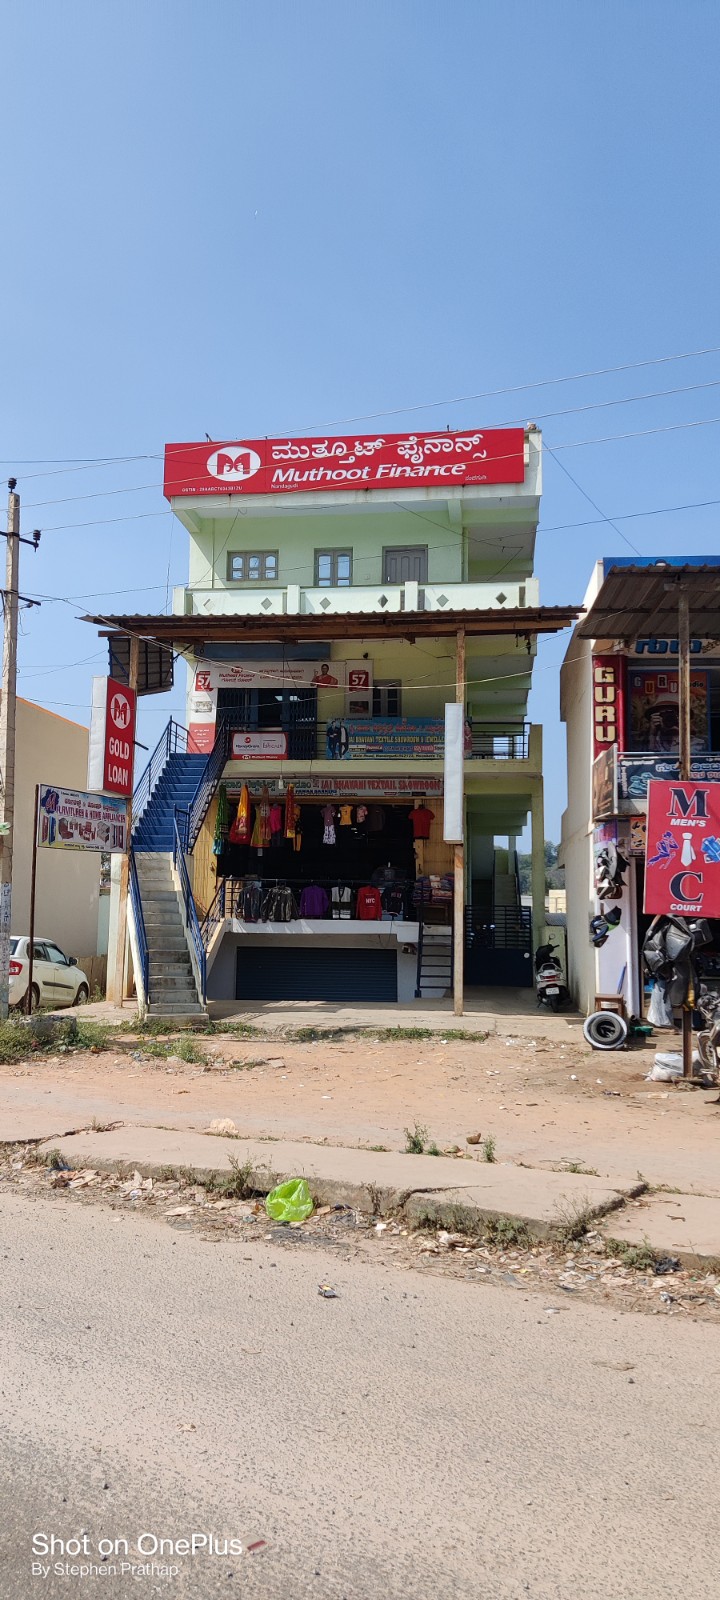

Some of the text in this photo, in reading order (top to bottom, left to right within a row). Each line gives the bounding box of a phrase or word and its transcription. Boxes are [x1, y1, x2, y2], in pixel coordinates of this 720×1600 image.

[272, 433, 487, 464] ಮುತ್ತೂಟ್ ಫೈನಾನ್ಸ್
[272, 463, 466, 483] Muthoot Finance
[197, 674, 211, 686] 57
[351, 674, 366, 685] 57
[634, 674, 678, 693] GURU
[595, 667, 616, 742] GURU
[108, 737, 130, 760] GOLD
[107, 763, 128, 787] LOAN
[667, 787, 711, 818] M
[670, 818, 706, 828] MEN'S
[669, 871, 704, 904] C
[670, 903, 703, 913] COURT
